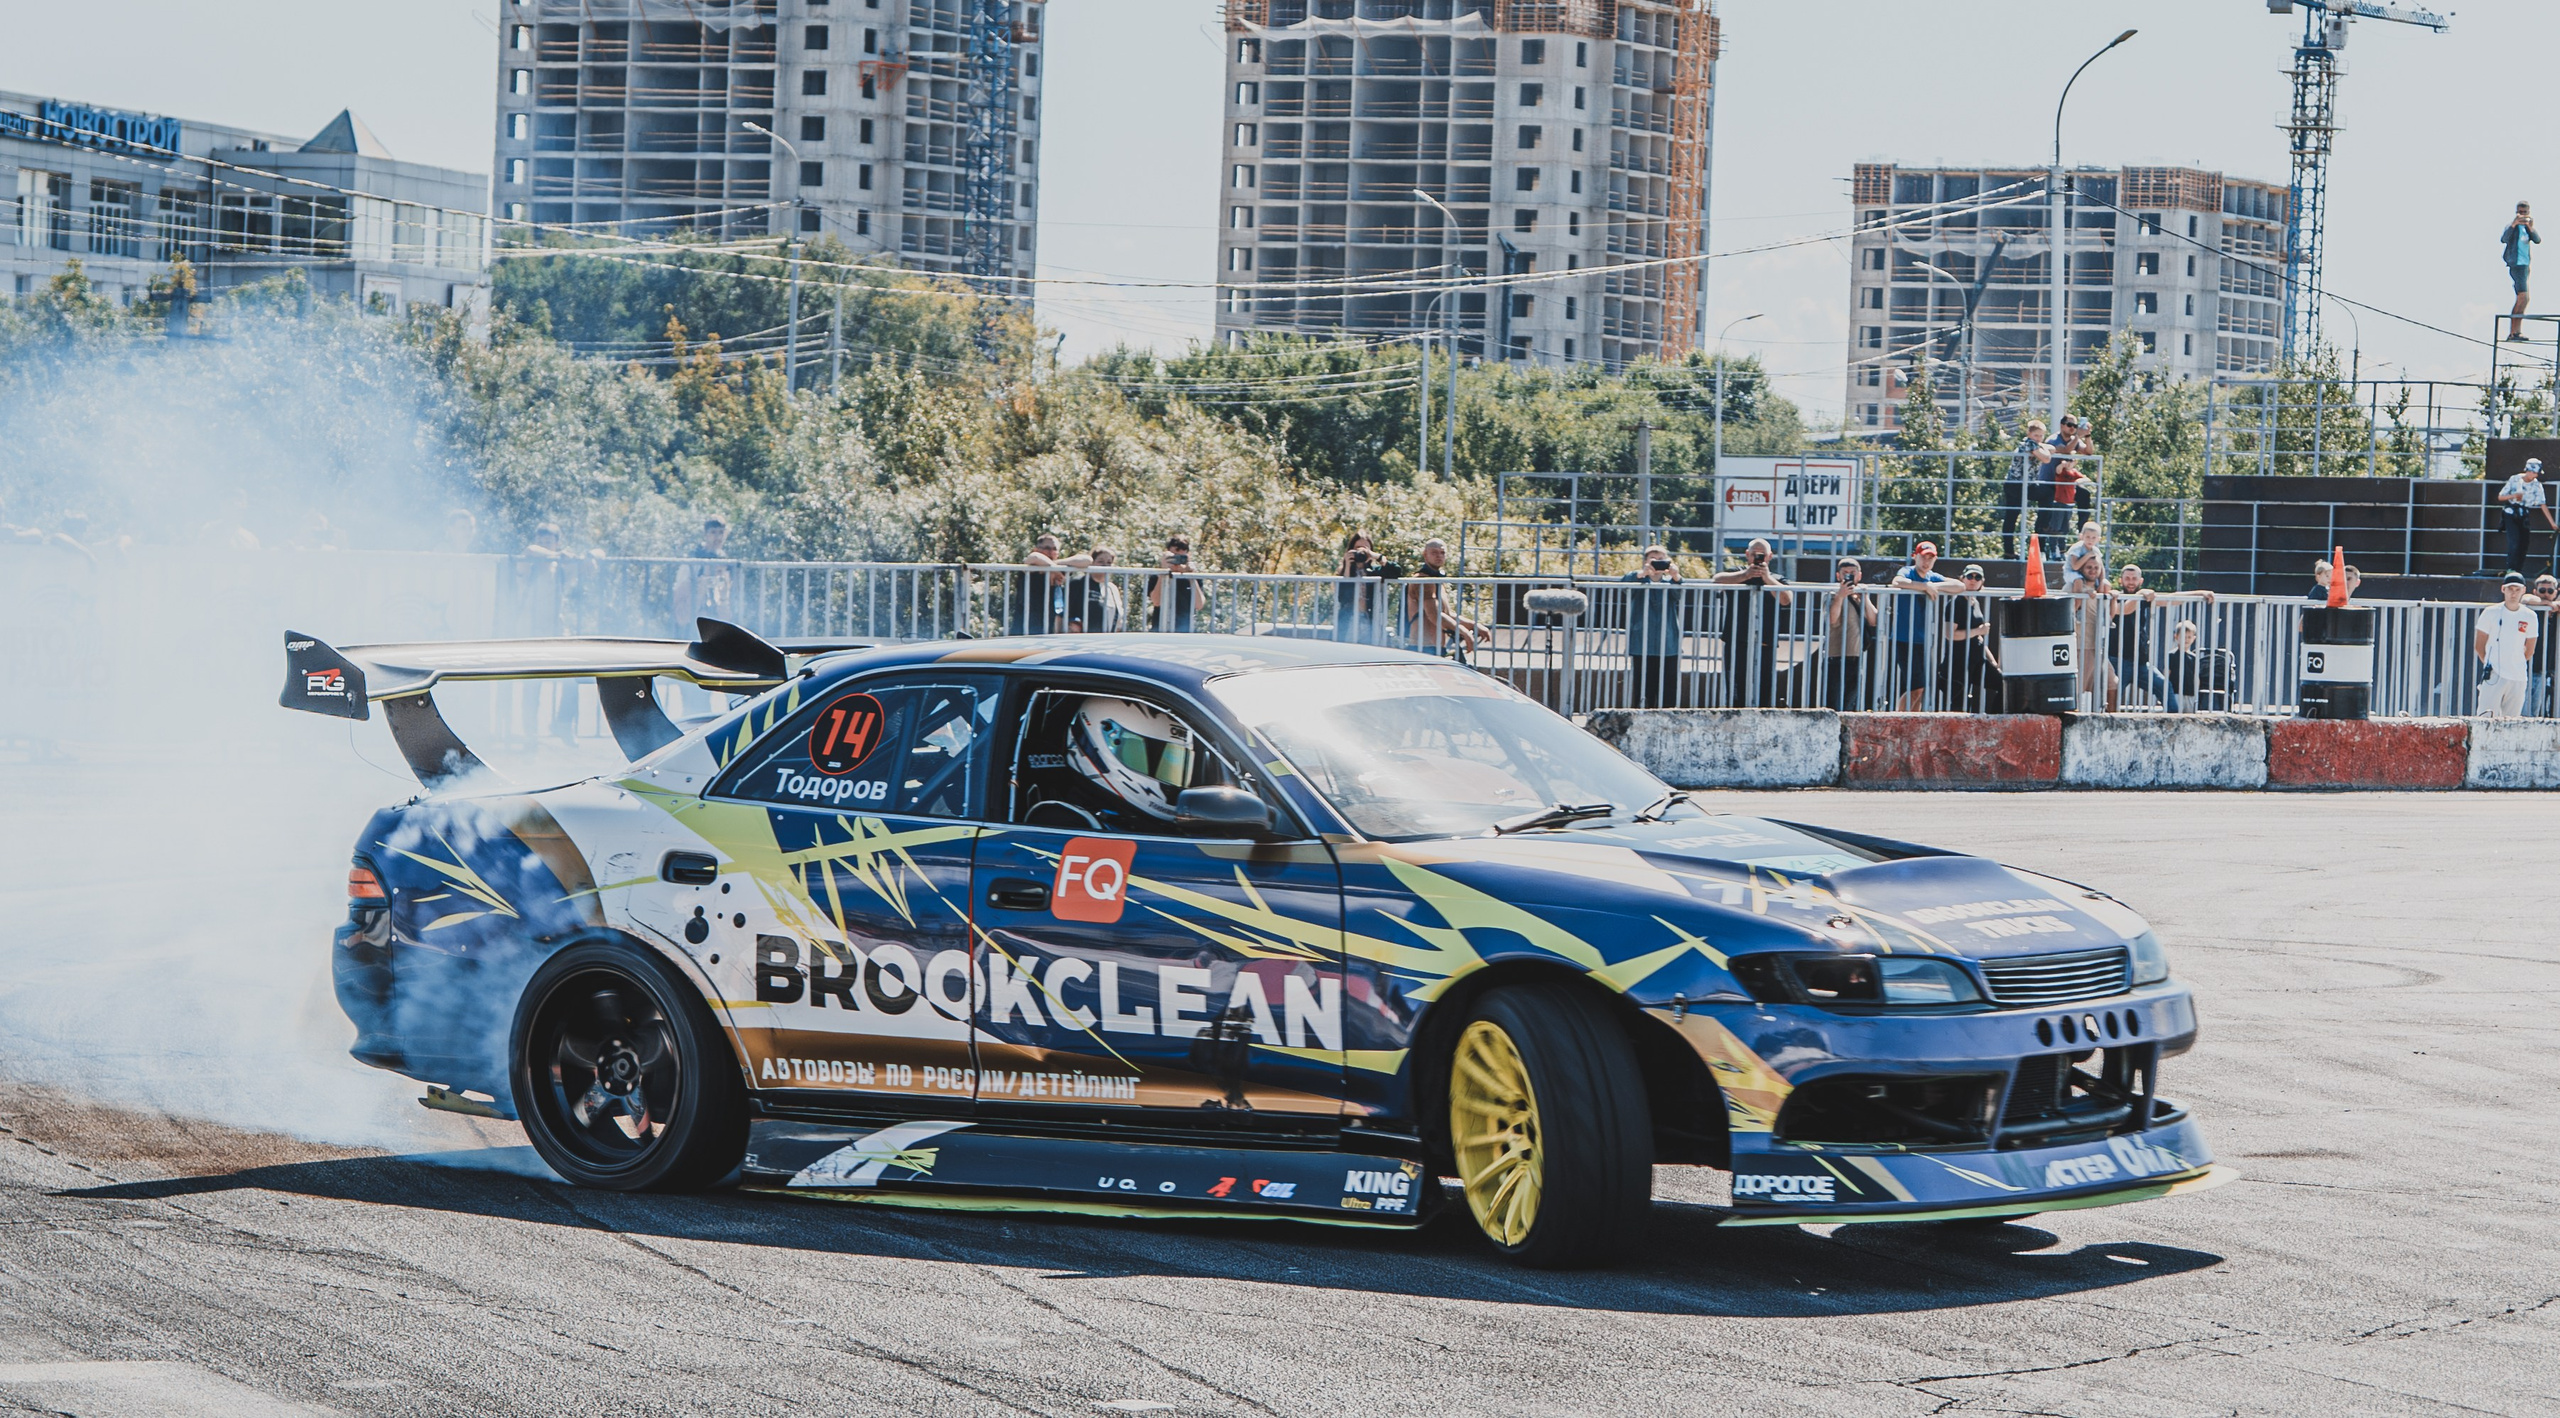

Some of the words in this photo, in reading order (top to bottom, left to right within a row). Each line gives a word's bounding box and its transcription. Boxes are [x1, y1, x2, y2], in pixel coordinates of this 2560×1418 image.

[2053, 649, 2069, 661] FQ
[2308, 655, 2323, 668] FQ
[822, 709, 875, 758] 14
[776, 767, 888, 804] Тодоров
[1057, 855, 1124, 900] FQ
[755, 933, 1342, 1051] BROOKCLEAN
[762, 1057, 876, 1085] АВТОВОЗЫ
[886, 1063, 912, 1087] ПО
[923, 1065, 1141, 1099] РОССИИ/ДЕТЕЙЛИНГ
[1343, 1170, 1410, 1196] KING
[1733, 1174, 1836, 1196] ДОРОГОЕ
